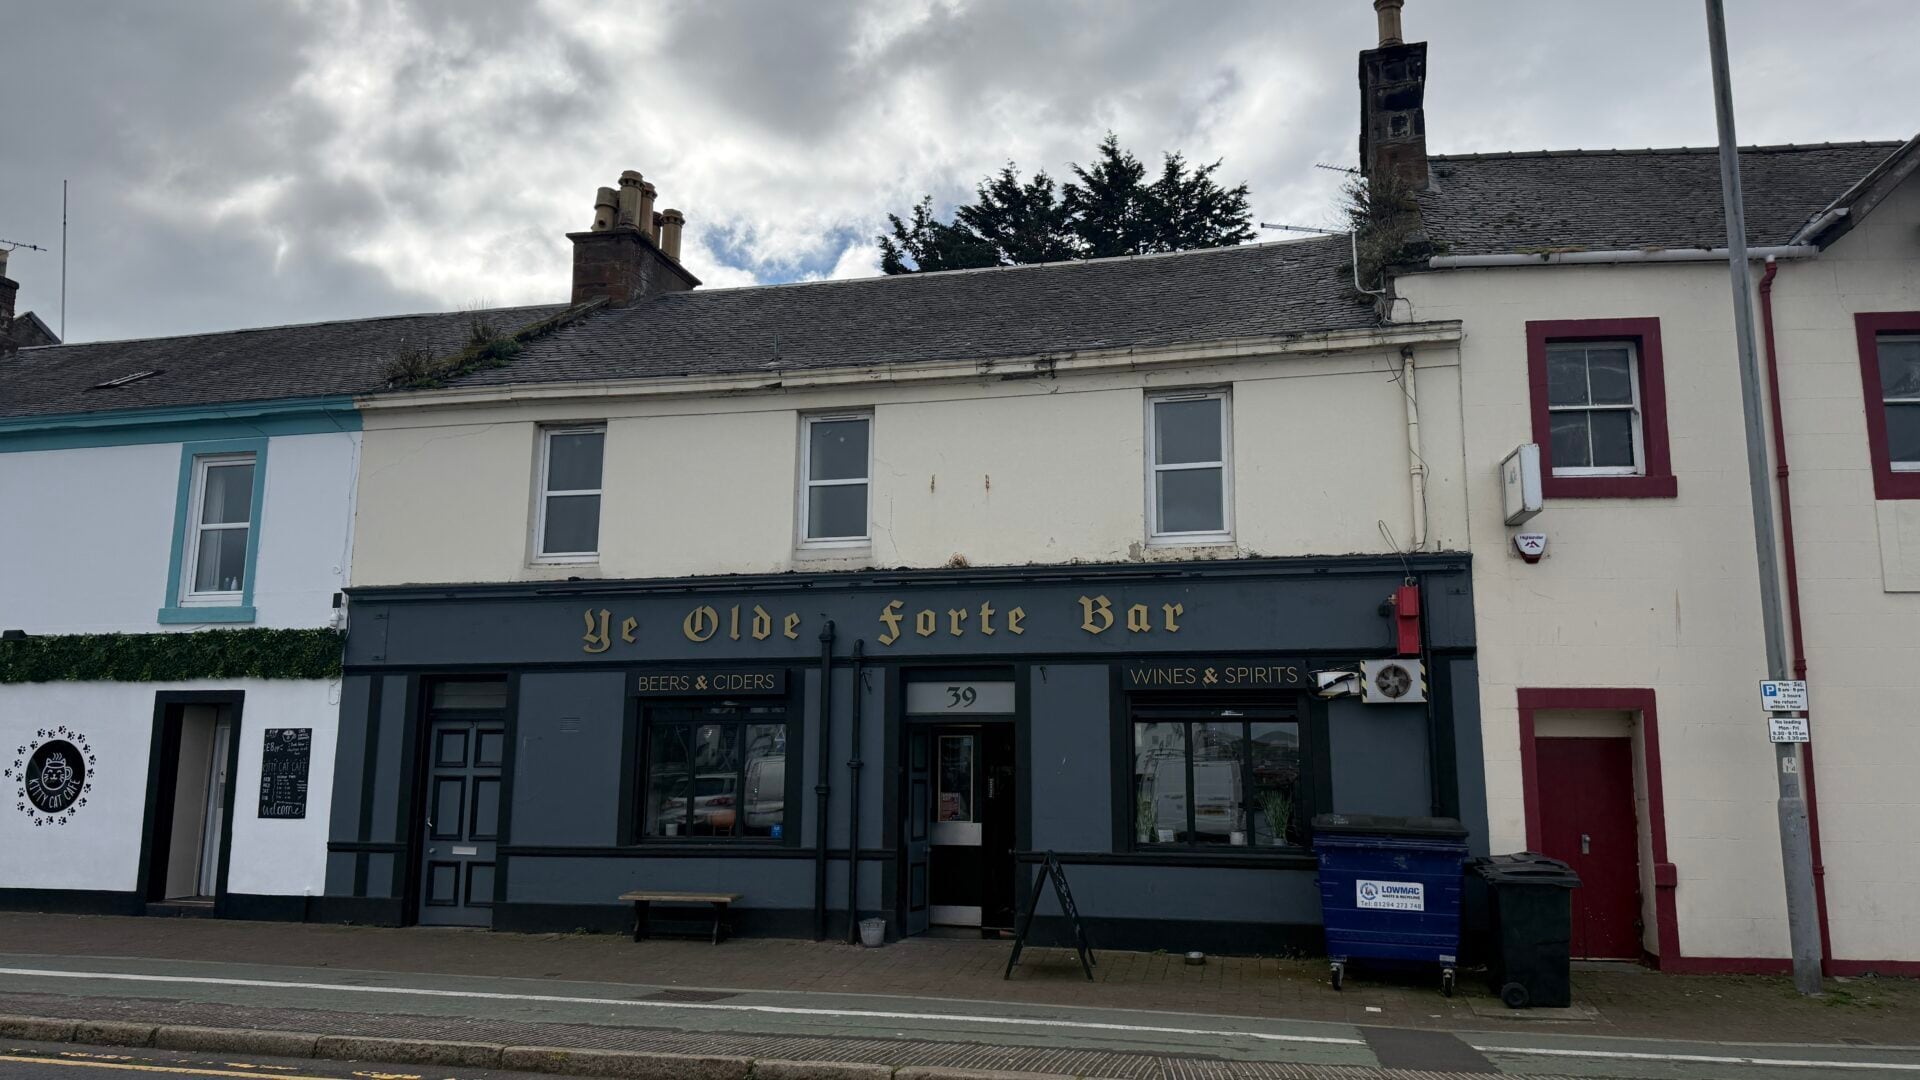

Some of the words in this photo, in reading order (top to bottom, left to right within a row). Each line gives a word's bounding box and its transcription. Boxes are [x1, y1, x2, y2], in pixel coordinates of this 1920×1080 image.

[582, 608, 638, 653] Ye
[683, 604, 800, 642] Olde
[878, 600, 1026, 646] Forte
[1078, 595, 1184, 635] Bar
[638, 675, 690, 691] BEERS
[694, 674, 708, 690] &
[713, 674, 775, 690] CIDERS
[1130, 667, 1196, 685] WINES
[1202, 666, 1219, 685] &
[1224, 666, 1298, 684] SPIRITS
[946, 686, 977, 708] 39
[29, 778, 48, 807] KITTY
[48, 794, 63, 808] CAT
[63, 779, 81, 801] CAFE
[1381, 885, 1420, 895] LOWMAC
